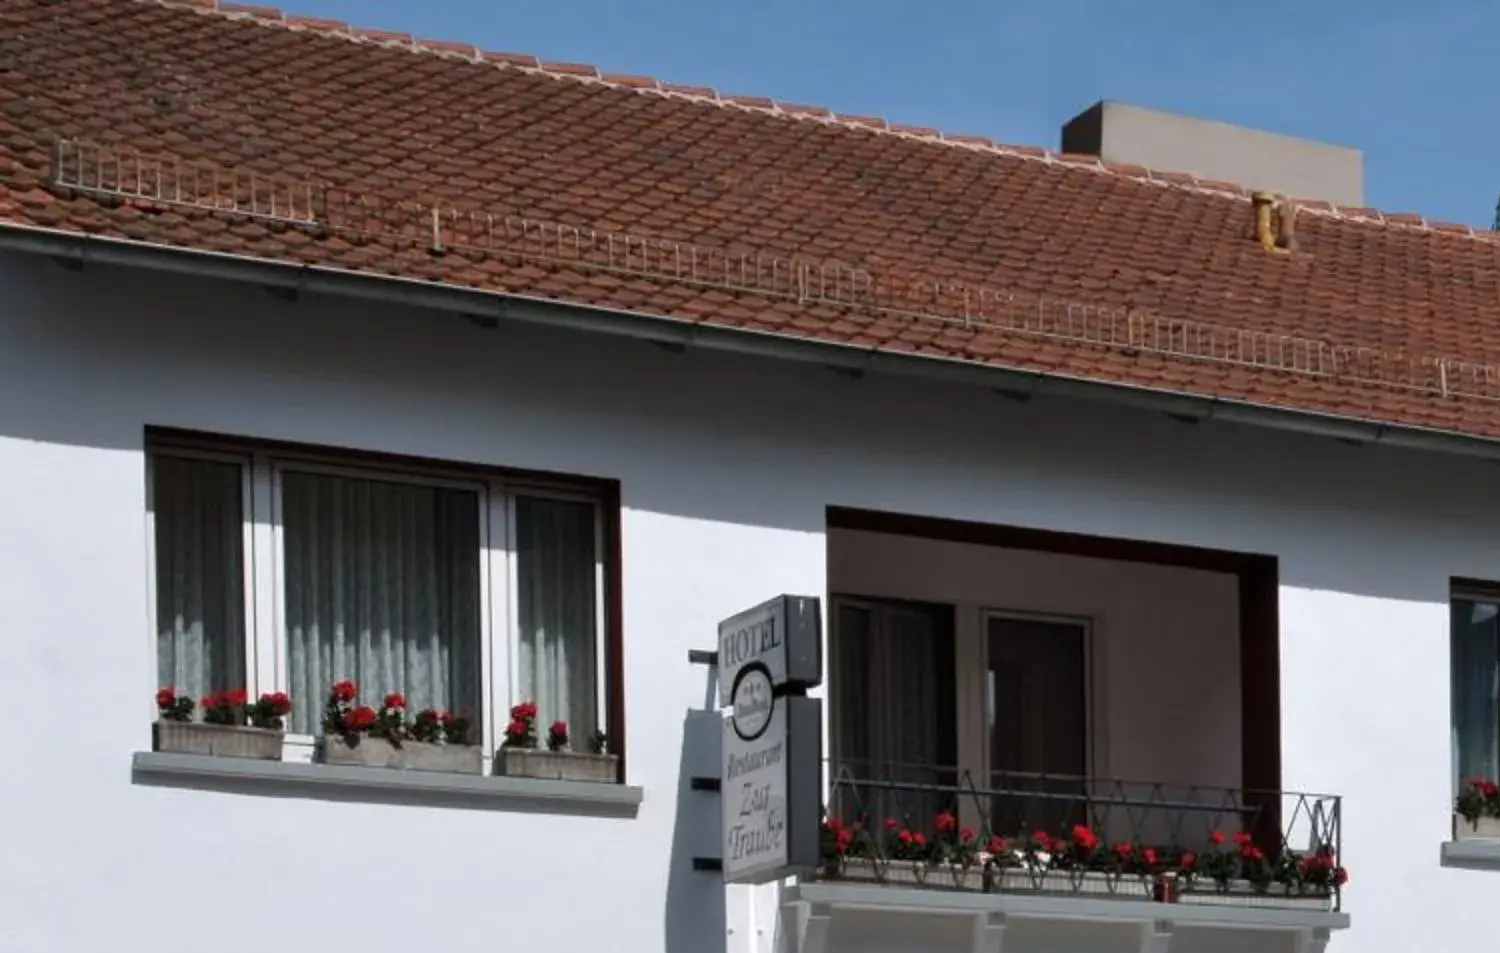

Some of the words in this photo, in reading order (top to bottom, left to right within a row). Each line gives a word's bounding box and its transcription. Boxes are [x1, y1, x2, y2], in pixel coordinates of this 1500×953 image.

[722, 616, 782, 670] HOTEL
[727, 742, 783, 782] Restaurant
[739, 782, 771, 818] Zur
[728, 809, 784, 861] Traube
